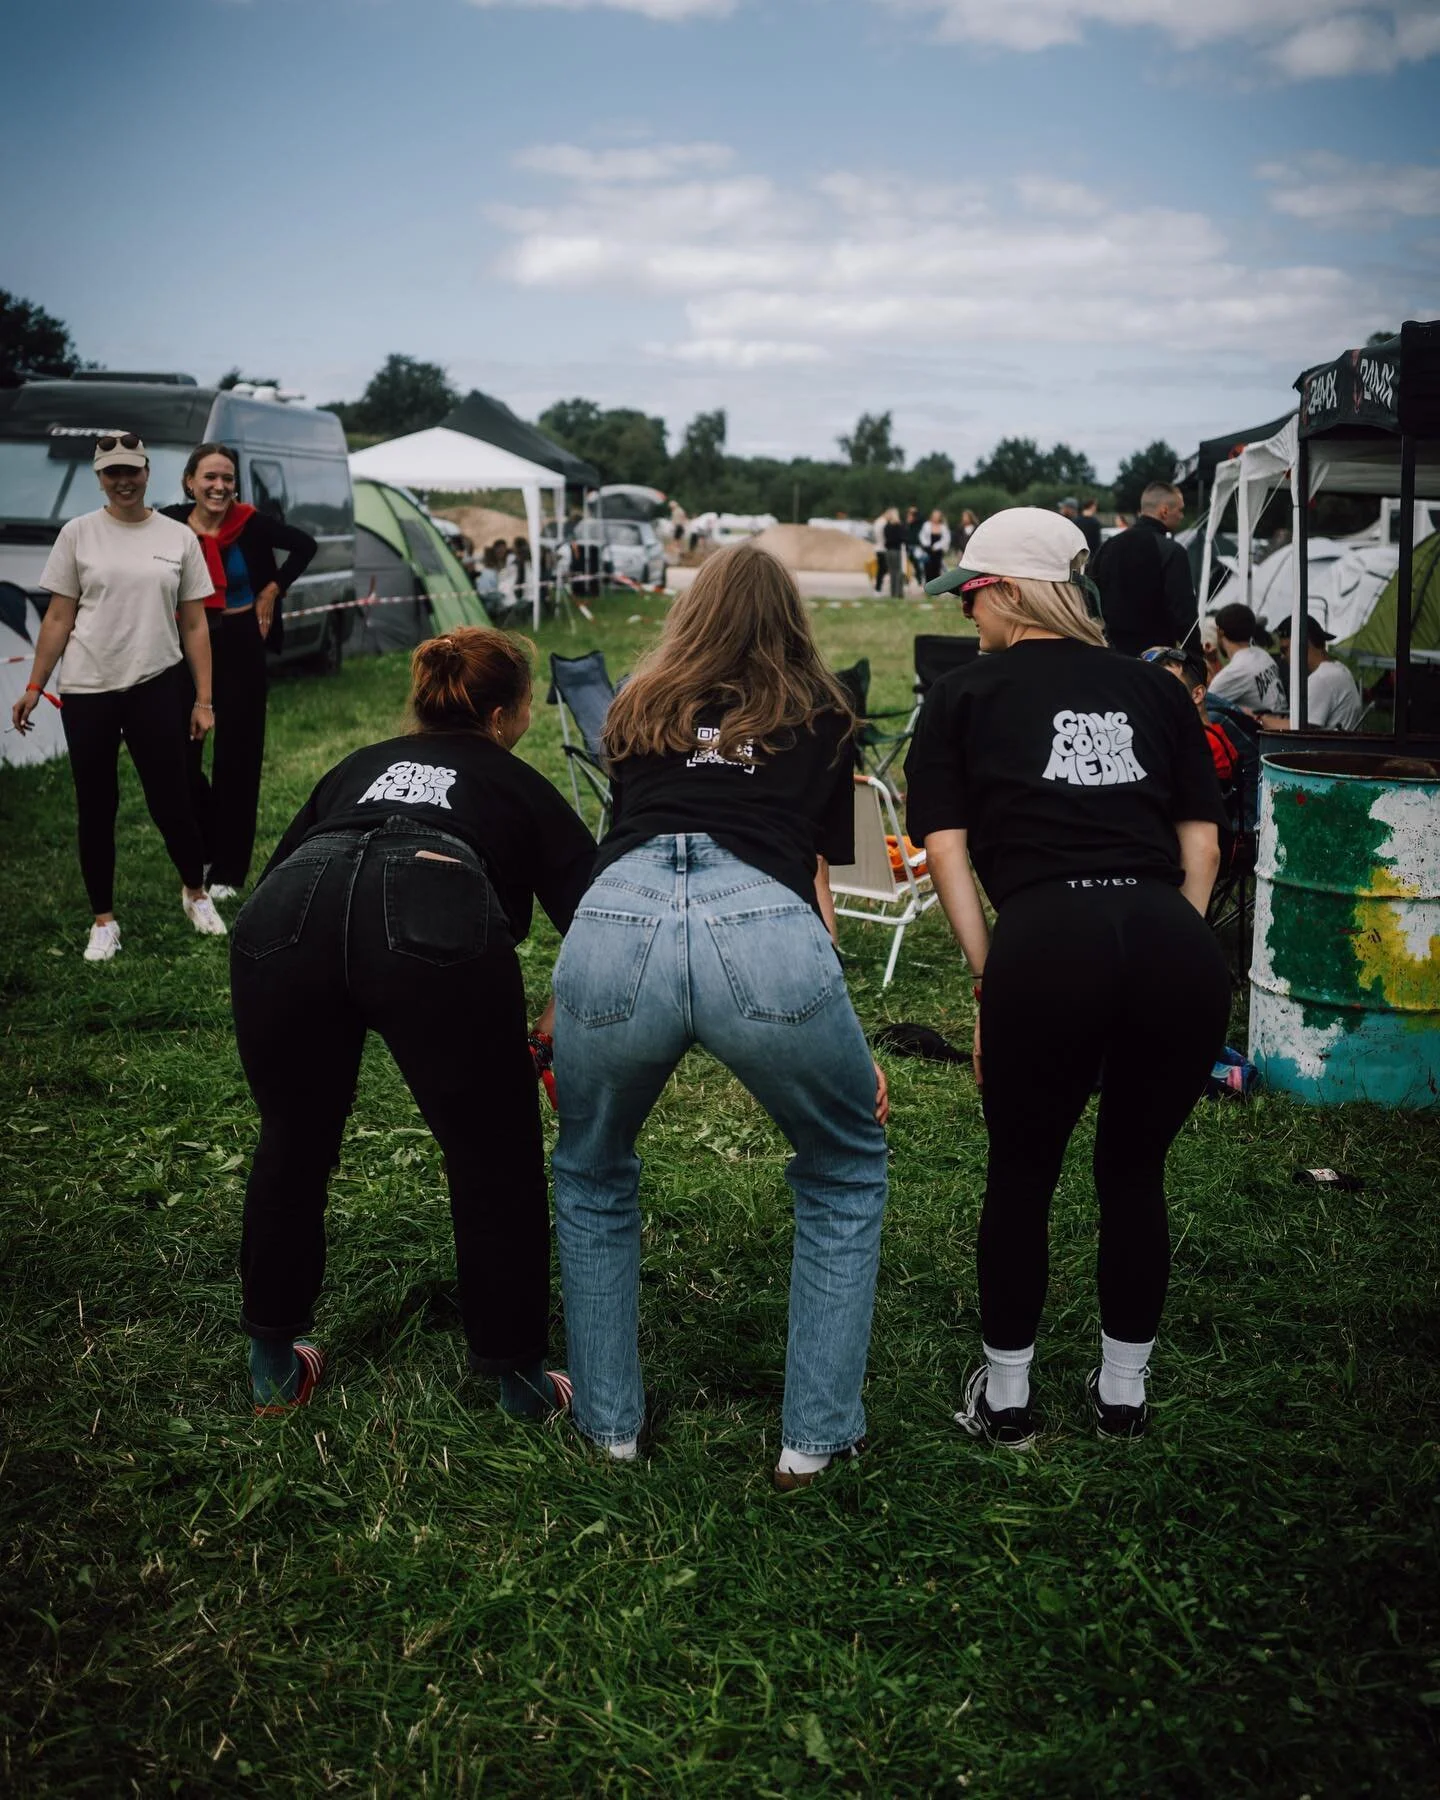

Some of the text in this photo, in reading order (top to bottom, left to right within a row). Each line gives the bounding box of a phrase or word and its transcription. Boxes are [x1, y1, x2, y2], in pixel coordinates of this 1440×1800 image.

[1052, 732, 1132, 757] COOL
[1042, 747, 1148, 785] MEDIA
[357, 781, 452, 809] MEDIA
[1067, 878, 1137, 888] TEVEO
